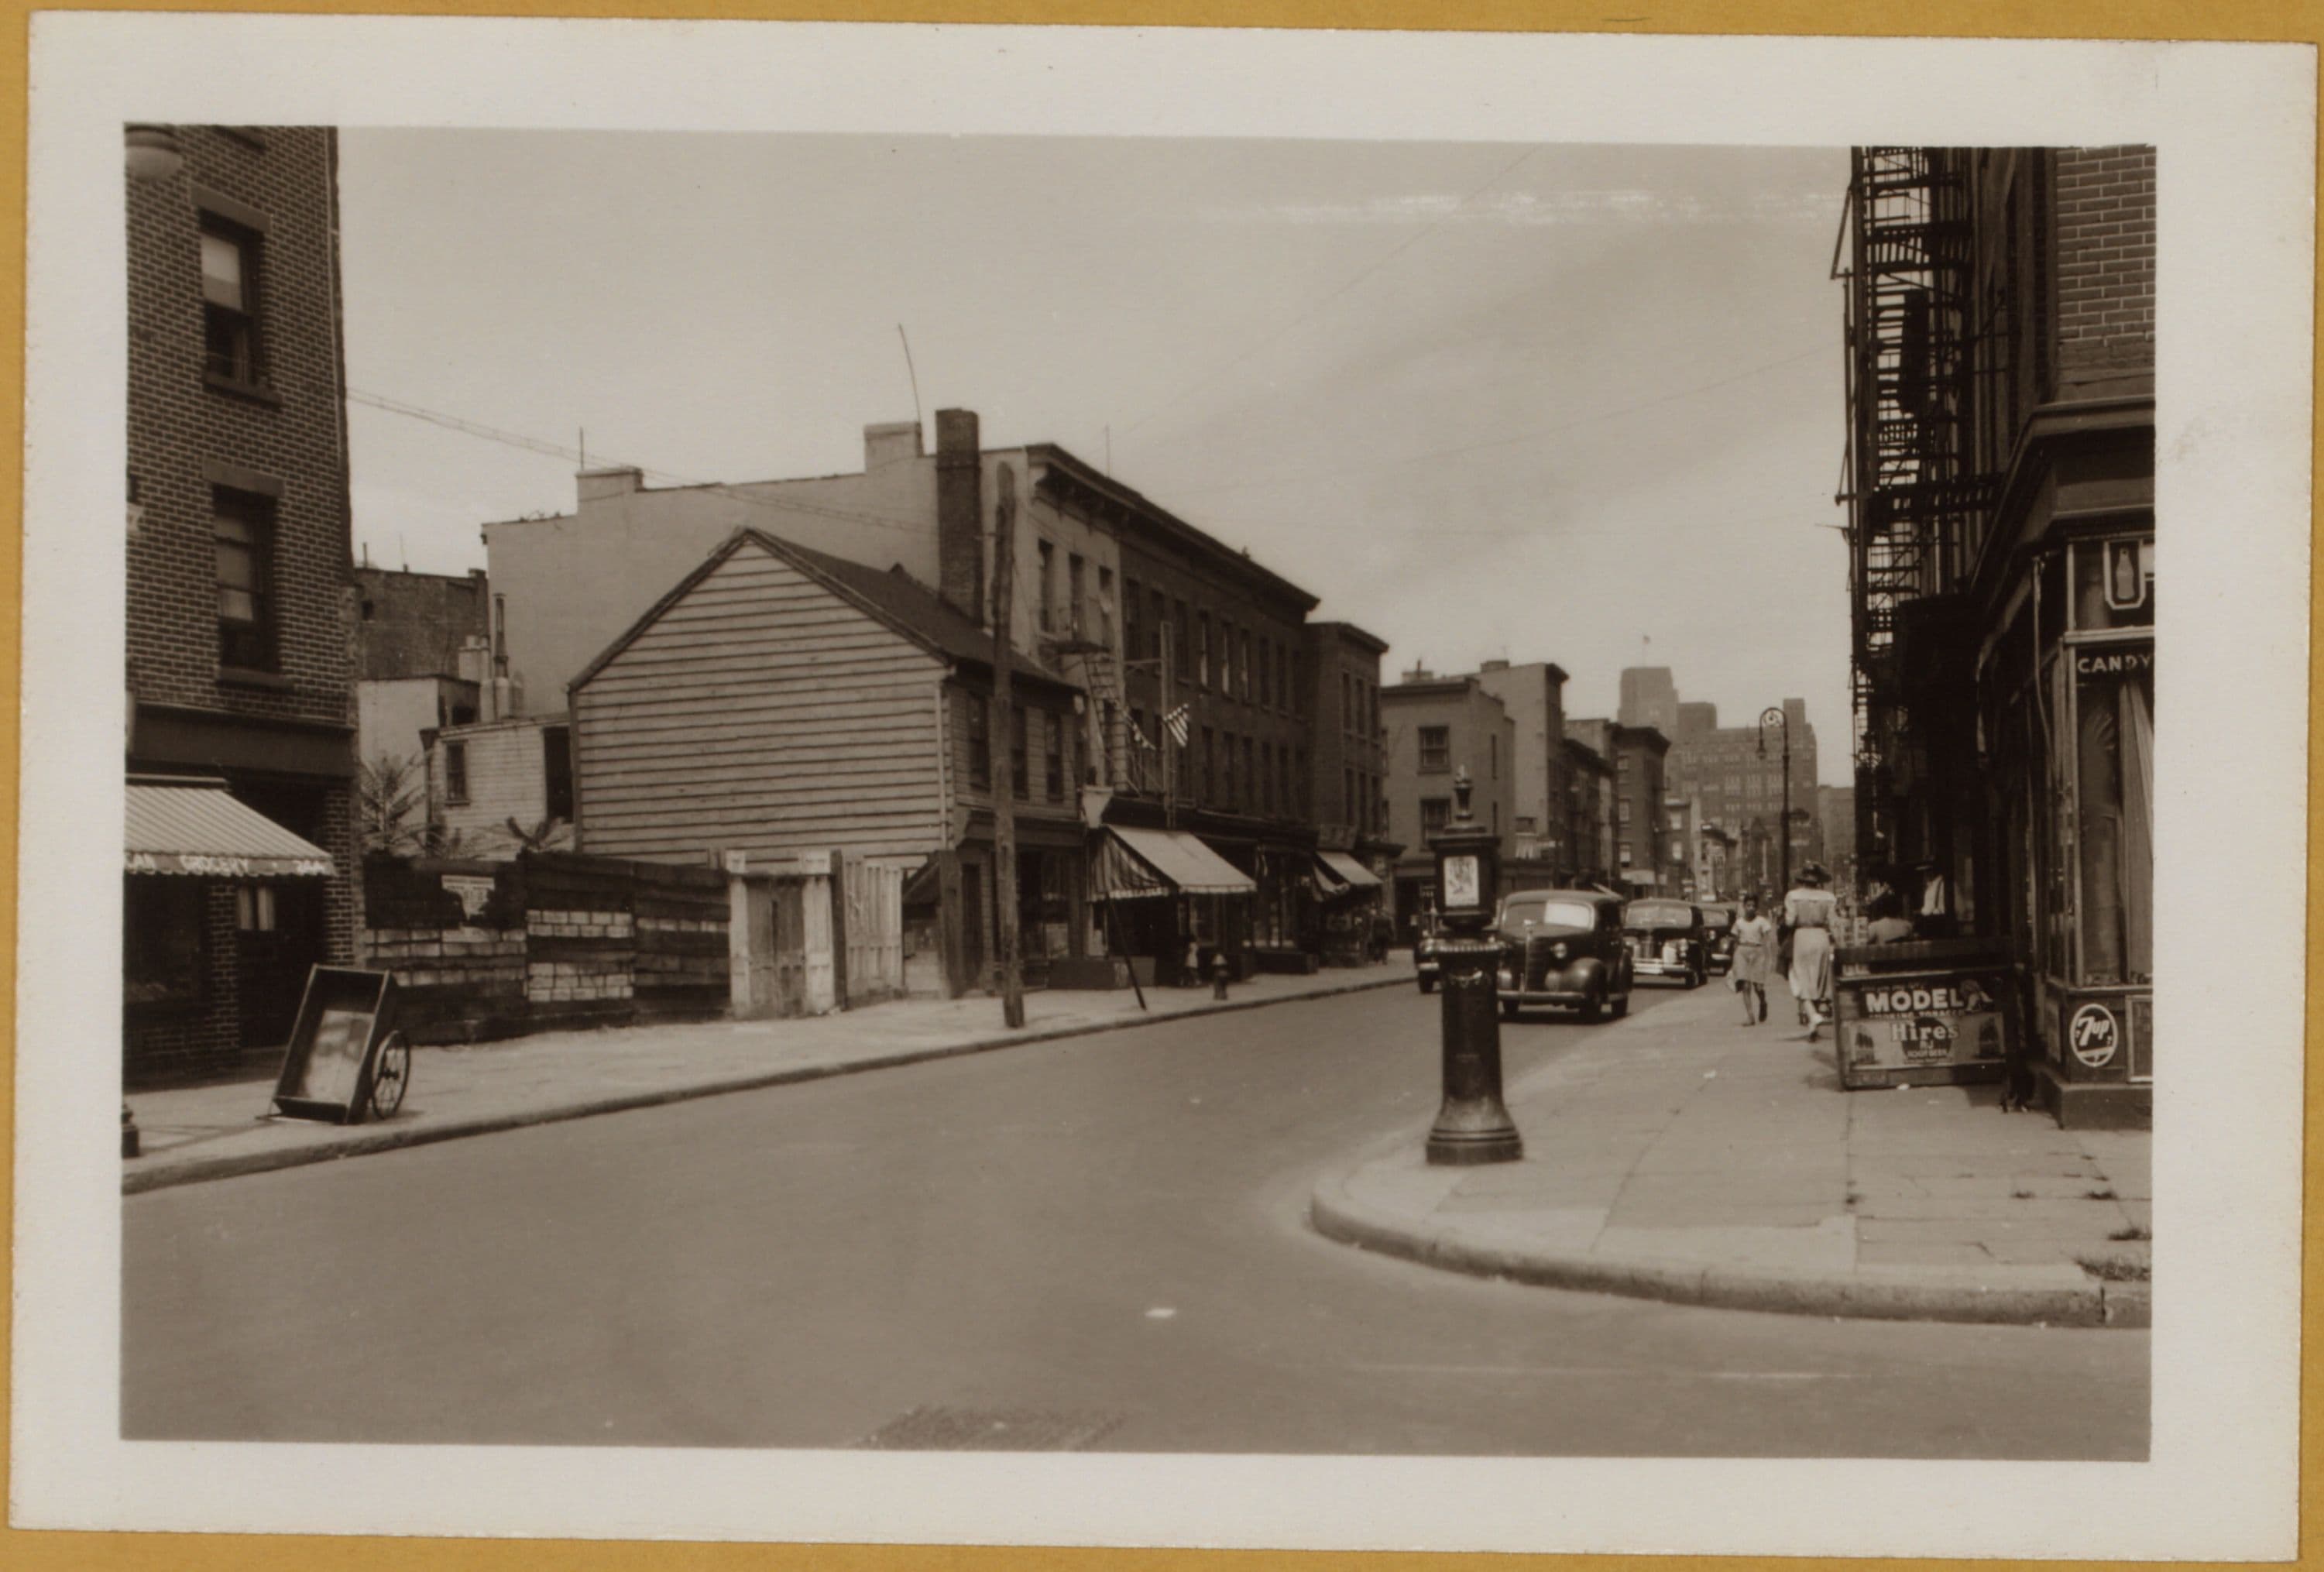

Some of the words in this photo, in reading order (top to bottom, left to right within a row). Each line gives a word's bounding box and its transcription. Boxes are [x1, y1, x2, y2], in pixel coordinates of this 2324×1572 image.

[2077, 654, 2151, 673] CANDY
[180, 854, 249, 875] GROCERY
[1866, 988, 1964, 1012] MODEL
[1892, 1022, 1959, 1041] Hires
